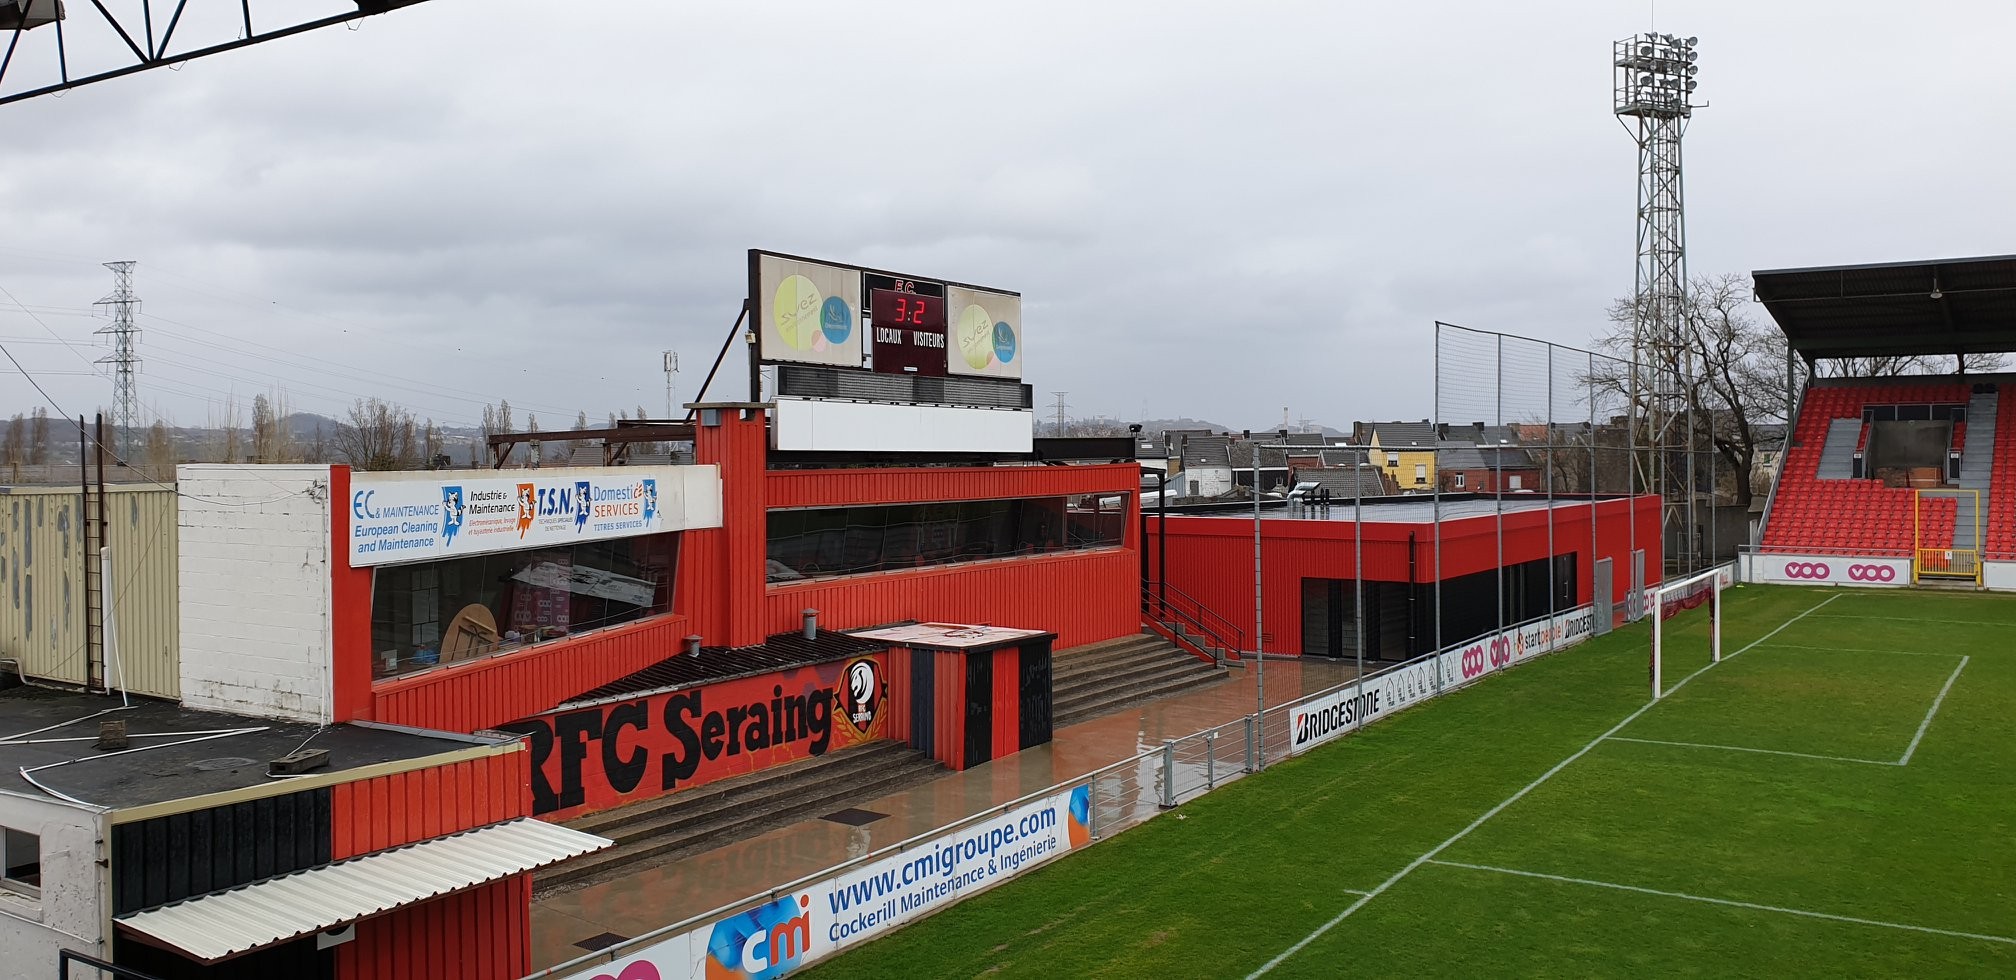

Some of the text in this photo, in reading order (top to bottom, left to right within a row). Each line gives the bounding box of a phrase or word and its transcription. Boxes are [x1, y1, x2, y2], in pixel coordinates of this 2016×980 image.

[895, 298, 926, 324] 3:2
[876, 327, 945, 348] LOCAUX VISITEURS
[470, 490, 508, 501] Industrie &
[538, 488, 574, 516] T.S.N.
[376, 508, 381, 518] &
[383, 504, 440, 518] MAINTENANCE
[468, 502, 515, 515] Maintenance
[594, 502, 639, 517] SERVICES
[354, 520, 438, 538] European Cleaning
[594, 520, 643, 532] TITRES SERVICES
[358, 537, 434, 554] and Maintenance
[1296, 689, 1380, 745] BRIDGESTONE
[497, 685, 833, 816] RFC Seraing
[829, 805, 1056, 915] www.cmigroupe.com
[829, 834, 1056, 942] Cockerill Maintenance & Ingénierie
[742, 894, 810, 973] cmi
